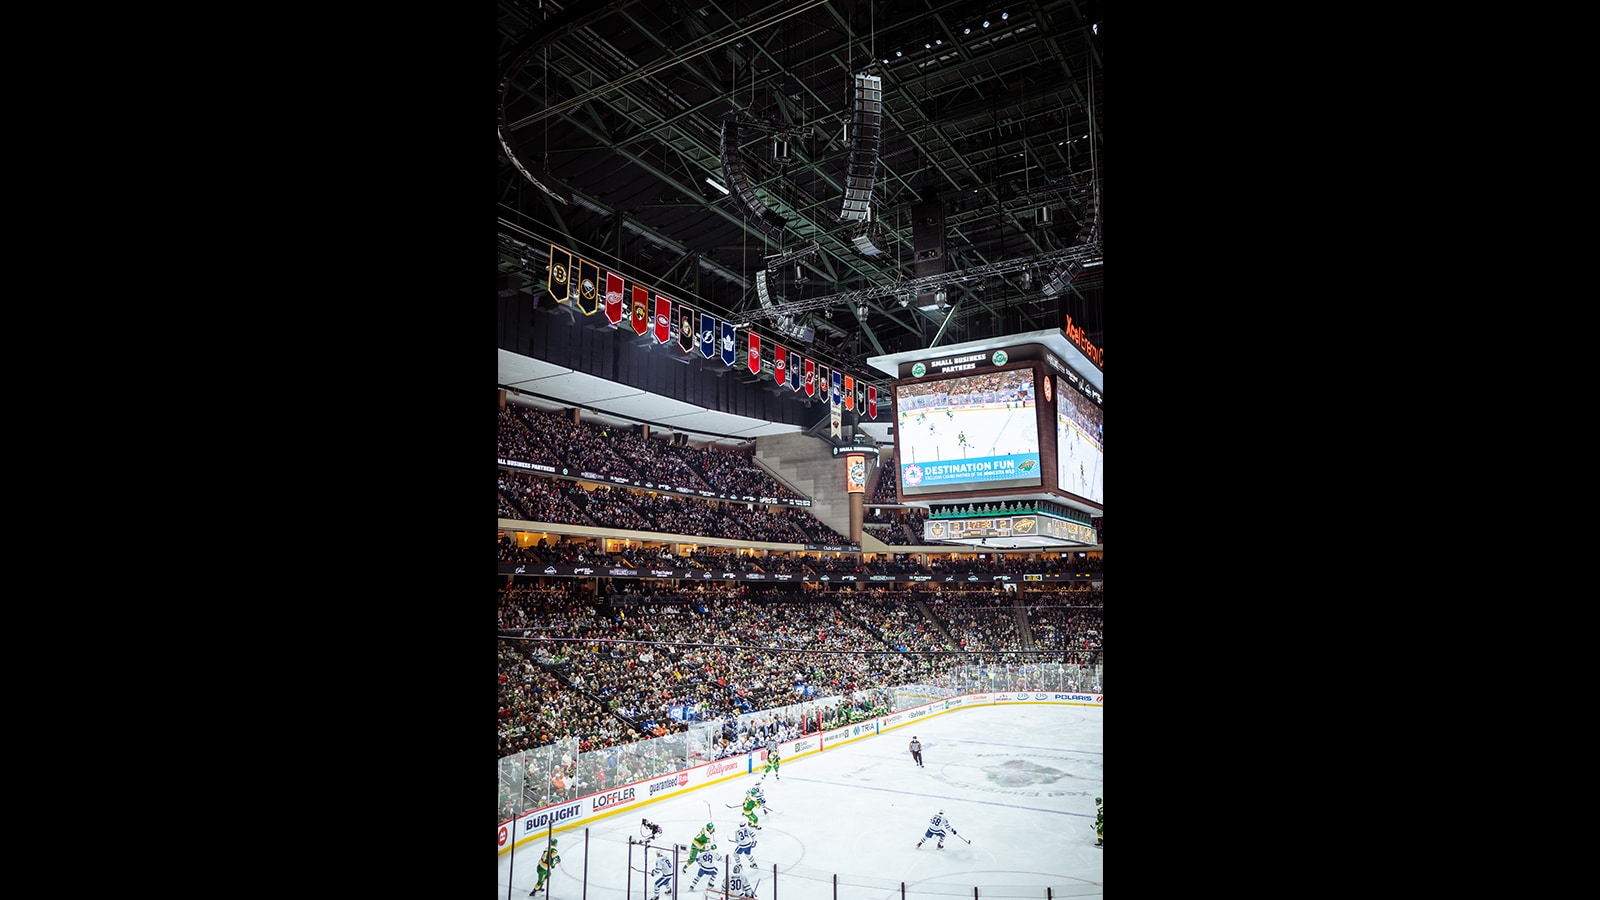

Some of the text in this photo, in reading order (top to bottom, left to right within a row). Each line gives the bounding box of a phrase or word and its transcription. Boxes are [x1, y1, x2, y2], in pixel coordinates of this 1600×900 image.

[1066, 313, 1081, 347] Xcel
[931, 354, 987, 368] SMALL BUSINESS
[941, 363, 976, 374] PARTNERS
[924, 459, 1015, 476] DESTINATION FUN
[999, 520, 1006, 529] 2
[861, 723, 875, 733] TRIA
[706, 763, 724, 778] Bally
[649, 775, 678, 796] guaranteed
[592, 787, 635, 809] LOFFLER
[526, 804, 581, 831] BUD LIGHT
[738, 829, 749, 841] 34
[729, 879, 741, 891] 30
